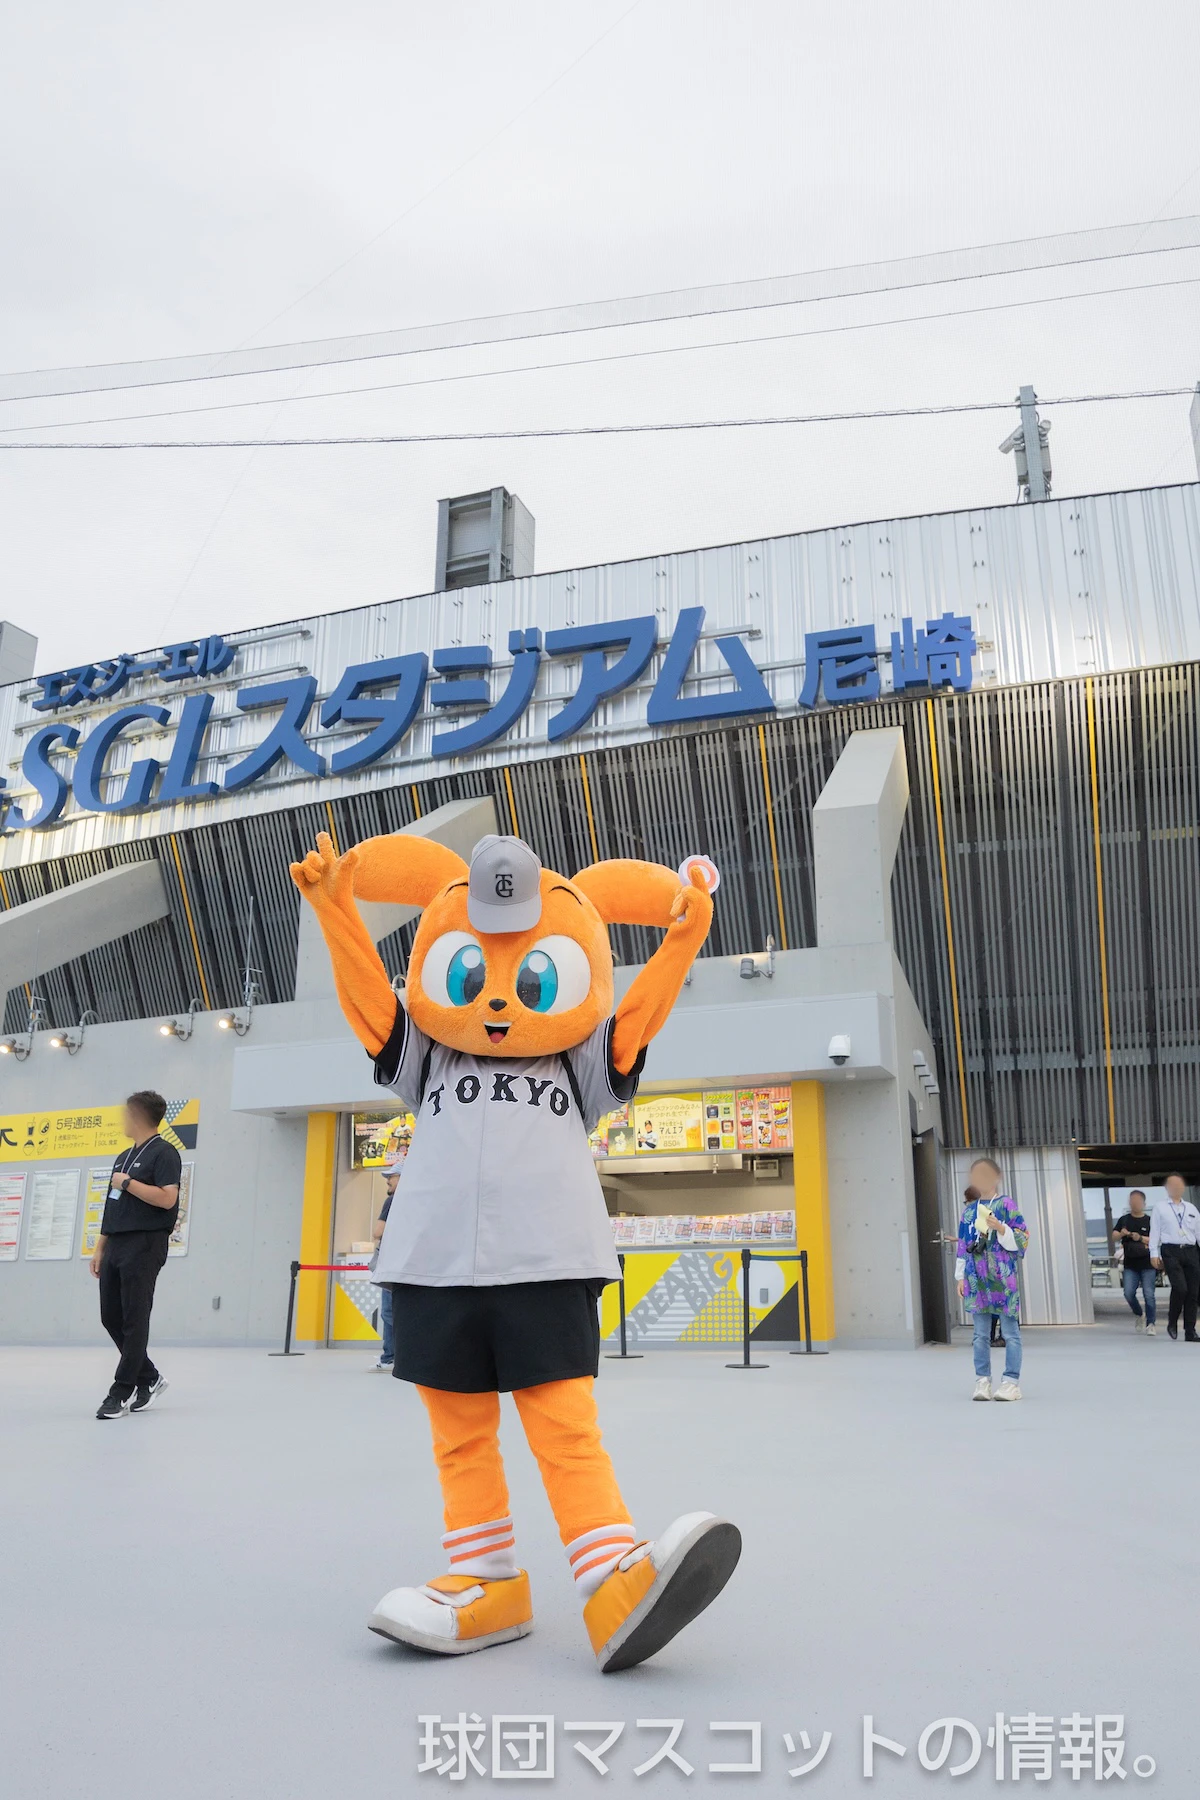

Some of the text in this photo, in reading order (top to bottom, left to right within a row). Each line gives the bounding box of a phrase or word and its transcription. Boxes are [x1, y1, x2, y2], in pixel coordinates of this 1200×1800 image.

[31, 634, 236, 712] エスジーエル
[426, 1072, 571, 1118] TOKYO
[56, 1115, 102, 1131] 5号通路奥
